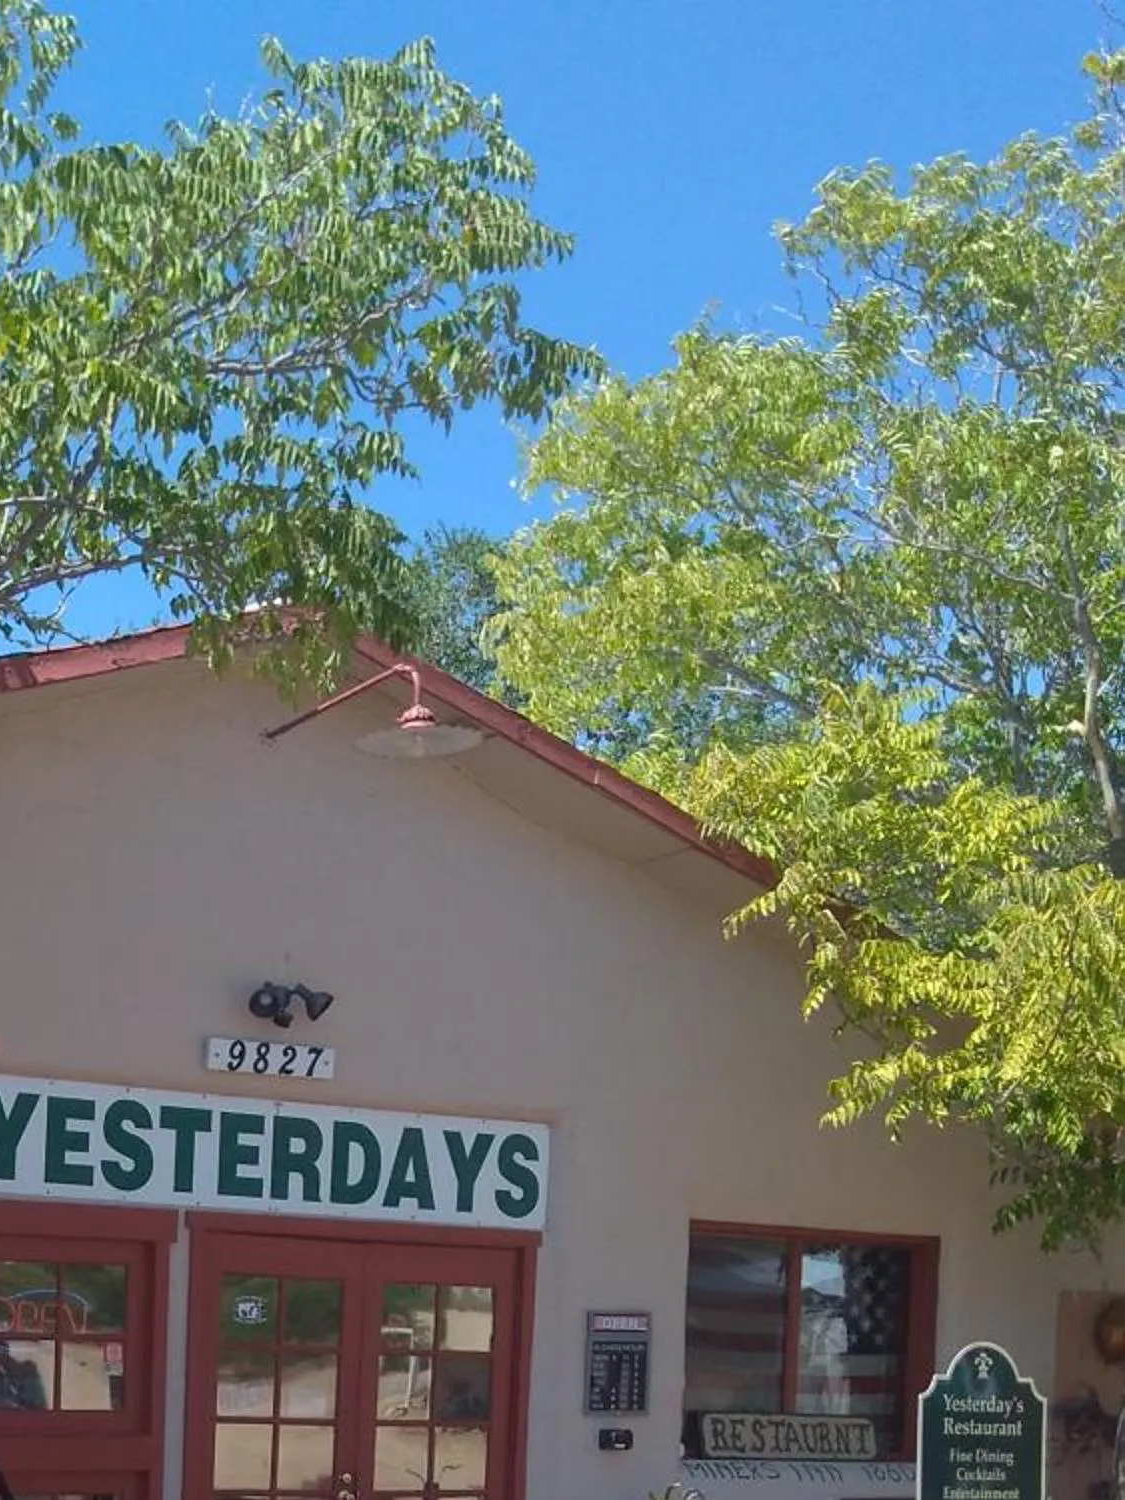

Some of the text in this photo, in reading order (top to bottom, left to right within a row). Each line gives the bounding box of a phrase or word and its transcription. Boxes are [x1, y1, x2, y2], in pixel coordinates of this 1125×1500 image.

[227, 1040, 324, 1077] 9827
[943, 1393, 1025, 1418] Yesterday's
[943, 1417, 1023, 1436] Restaurant
[949, 1448, 1015, 1466] Fine Dining
[955, 1467, 1007, 1481] Cocktails
[942, 1485, 1021, 1500] Entertainment
